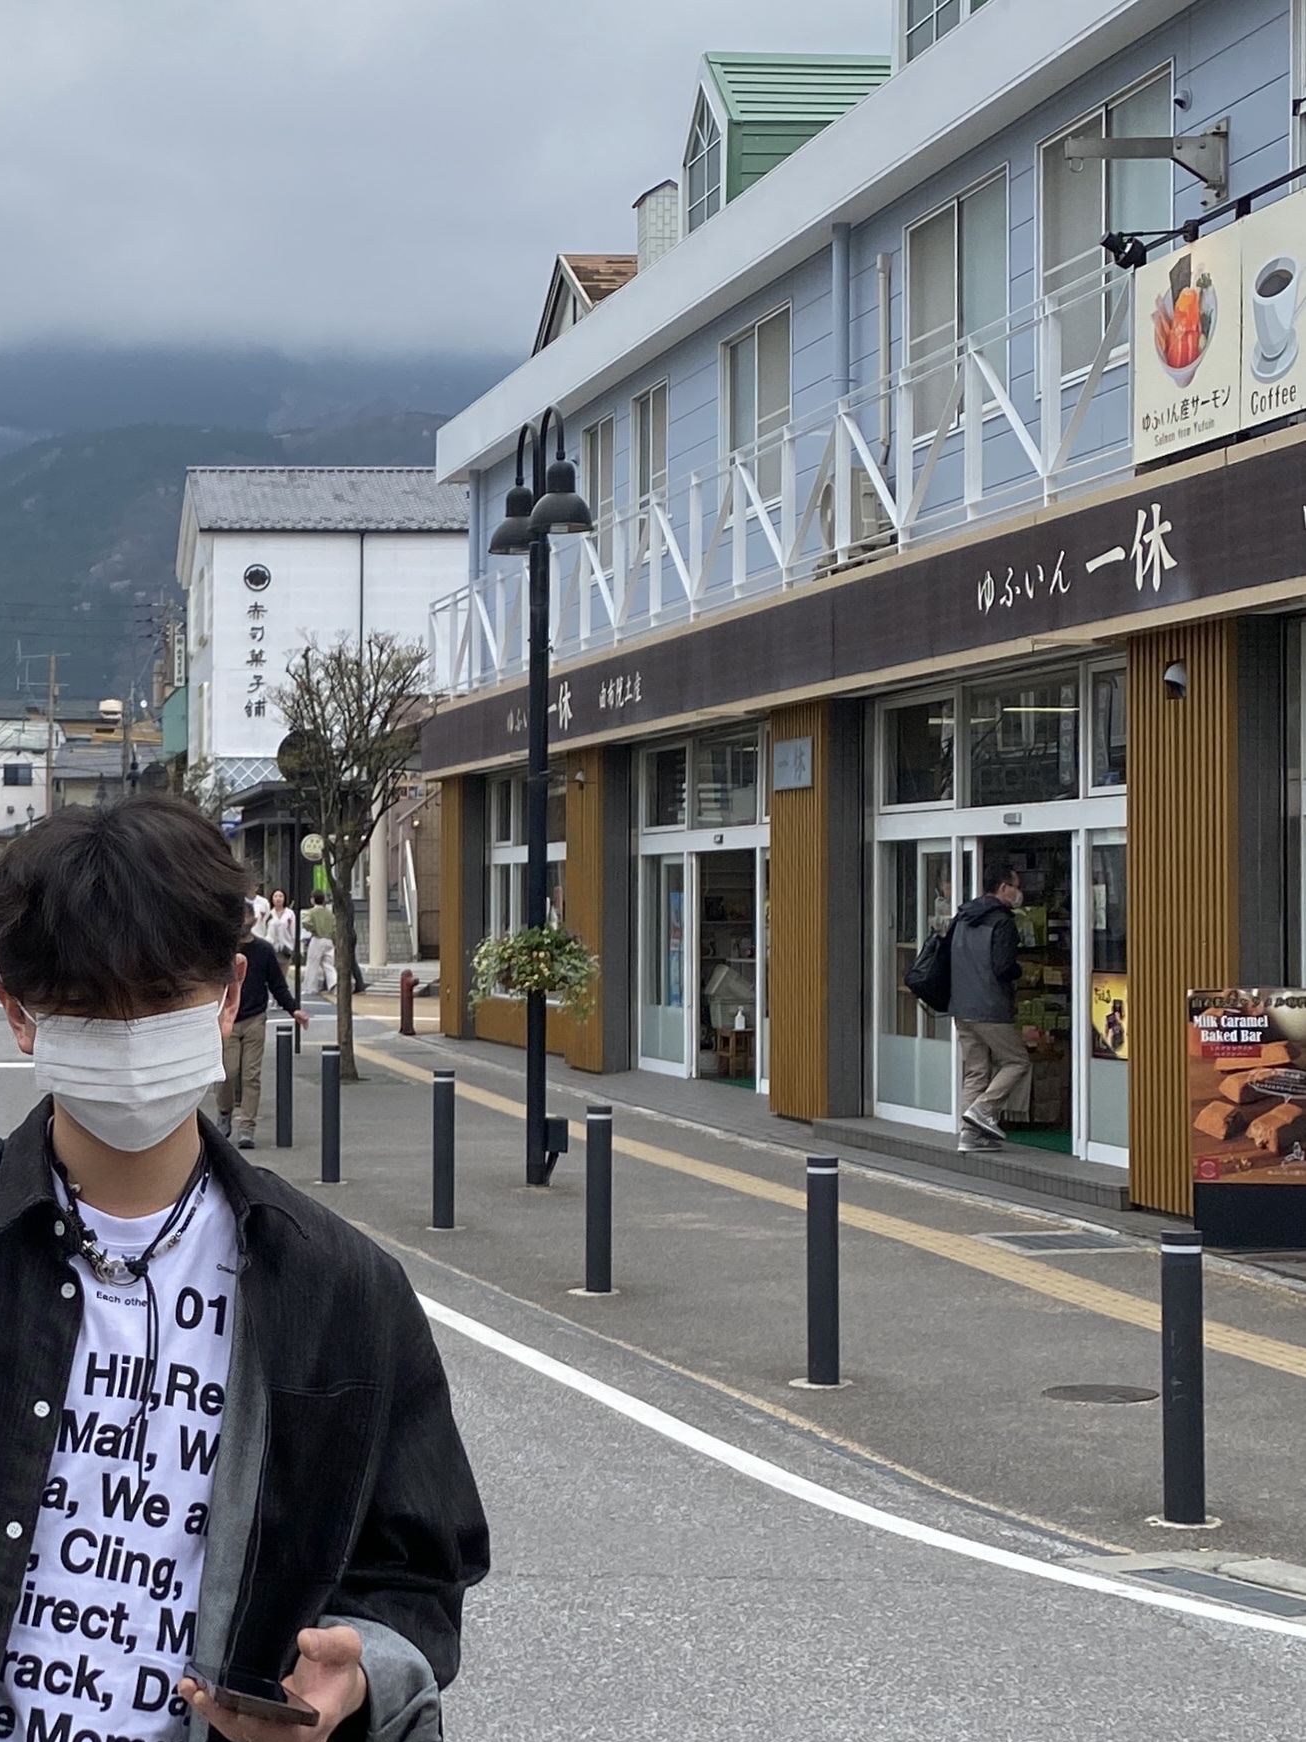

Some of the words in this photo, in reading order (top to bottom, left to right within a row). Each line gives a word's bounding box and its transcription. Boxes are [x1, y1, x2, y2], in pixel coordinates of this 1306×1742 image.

[1142, 385, 1231, 432] ゆふいん産サーモン
[1250, 384, 1297, 416] Coffee
[1154, 431, 1176, 447] Salmon
[1177, 426, 1191, 440] from
[977, 549, 1072, 615] ゆふいん
[1085, 502, 1178, 592] 一休
[777, 744, 806, 782] 一休
[1194, 1015, 1218, 1028] Milk
[1220, 1015, 1269, 1028] Caramel
[1200, 1030, 1238, 1042] Baked
[1240, 1030, 1263, 1042] Bar
[96, 1290, 121, 1304] Each
[124, 1296, 149, 1307] othe
[175, 1285, 228, 1336] 01
[55, 1408, 158, 1472] Mail,
[102, 1472, 170, 1528] We
[184, 1502, 209, 1536] a
[60, 1528, 183, 1601] Cling,
[18, 1580, 138, 1654] irect,
[132, 1665, 191, 1727] Da
